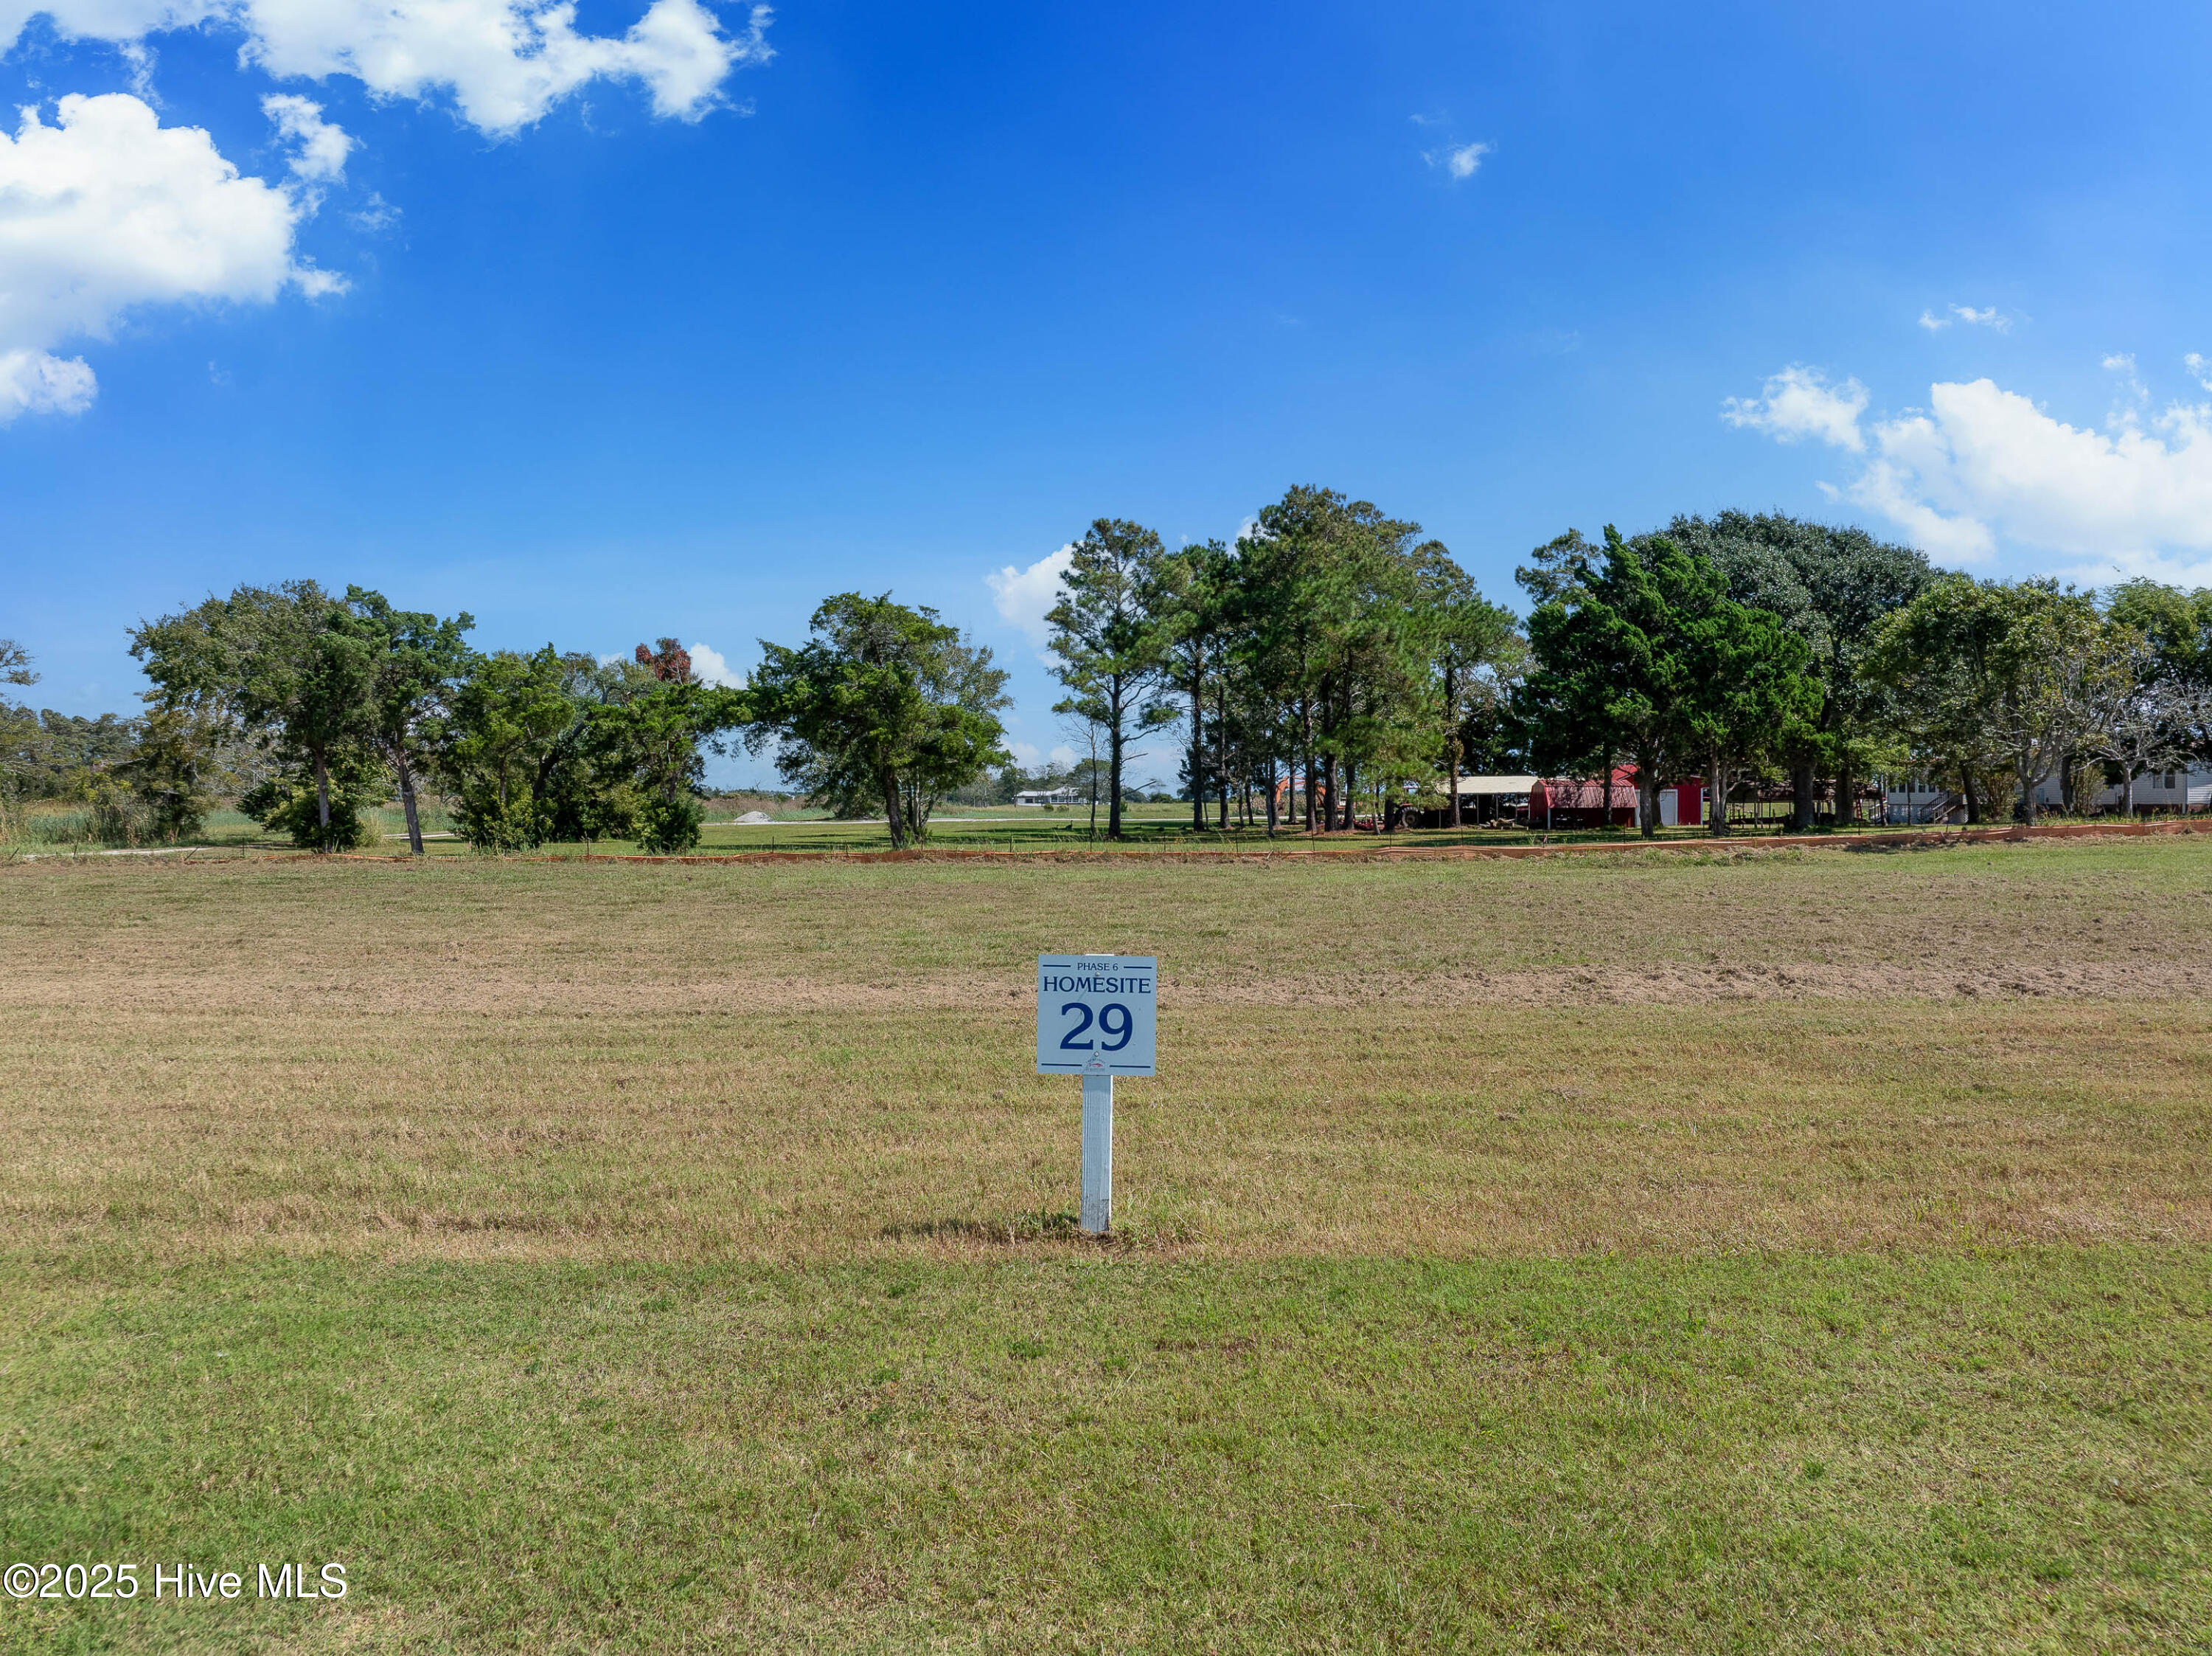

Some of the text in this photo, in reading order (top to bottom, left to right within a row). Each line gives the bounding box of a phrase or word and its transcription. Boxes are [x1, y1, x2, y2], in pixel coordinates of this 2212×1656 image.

[1077, 962, 1119, 971] PHASE 6
[1043, 976, 1151, 993] HOMESITE
[1060, 1002, 1133, 1051] 29
